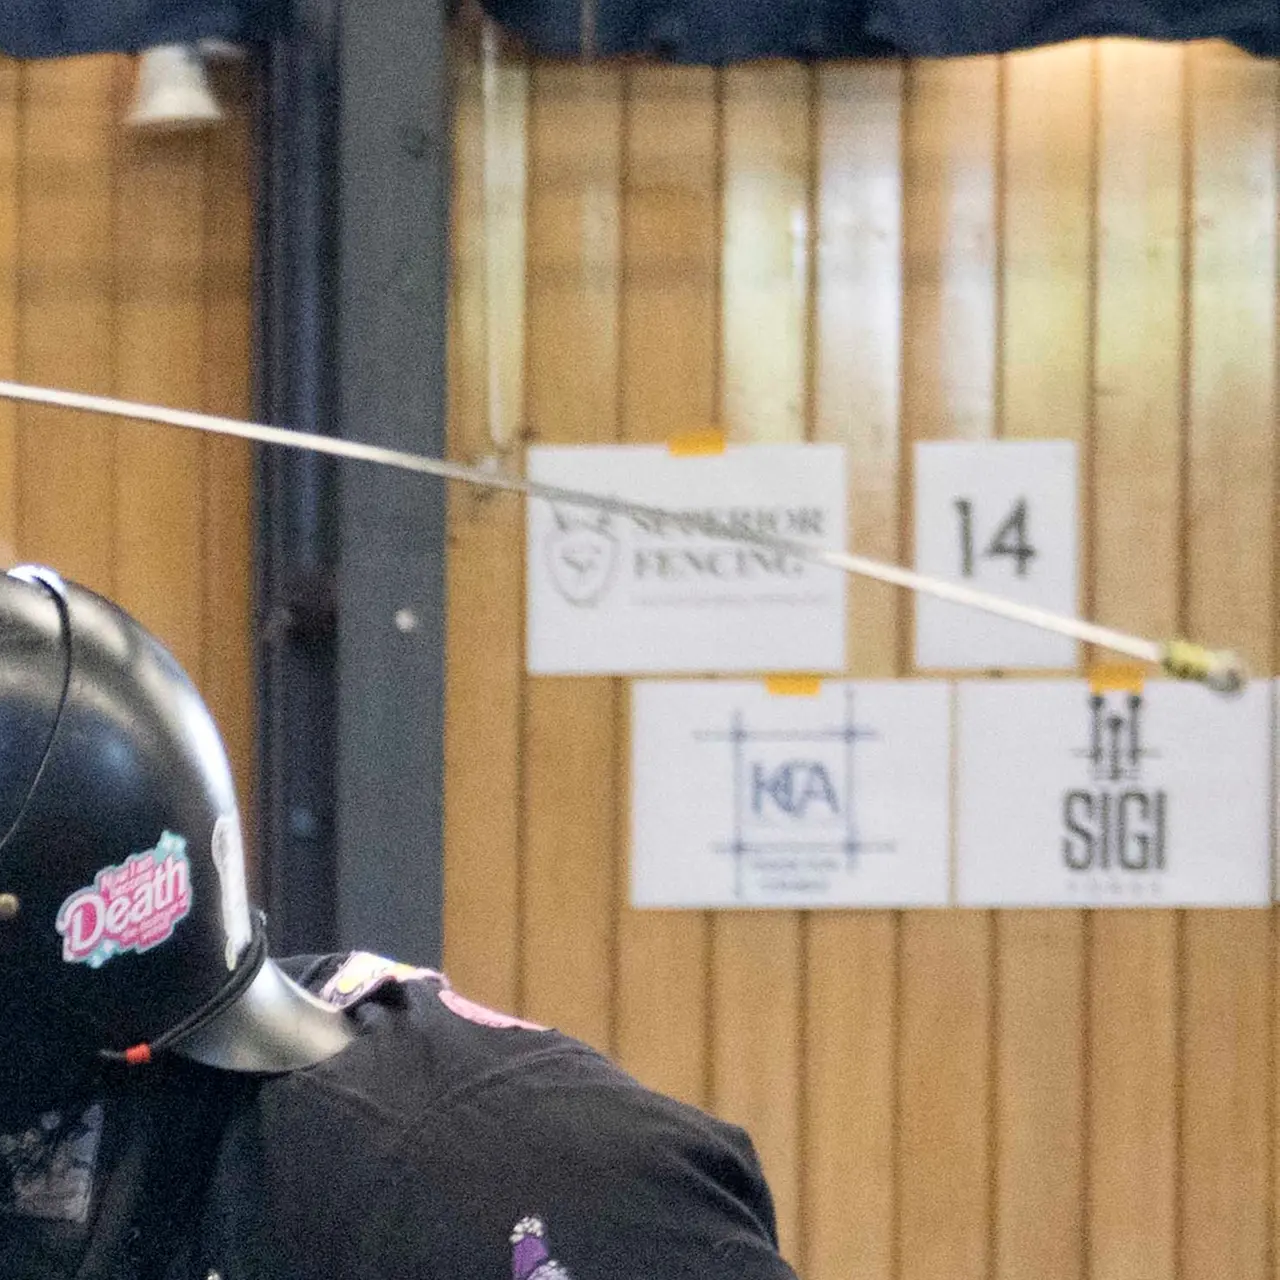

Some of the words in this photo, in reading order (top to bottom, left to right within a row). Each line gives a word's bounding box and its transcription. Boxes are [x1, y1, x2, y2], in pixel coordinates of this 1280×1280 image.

[953, 496, 1038, 577] 14
[1061, 788, 1167, 870] SIGI
[56, 855, 188, 952] Death
